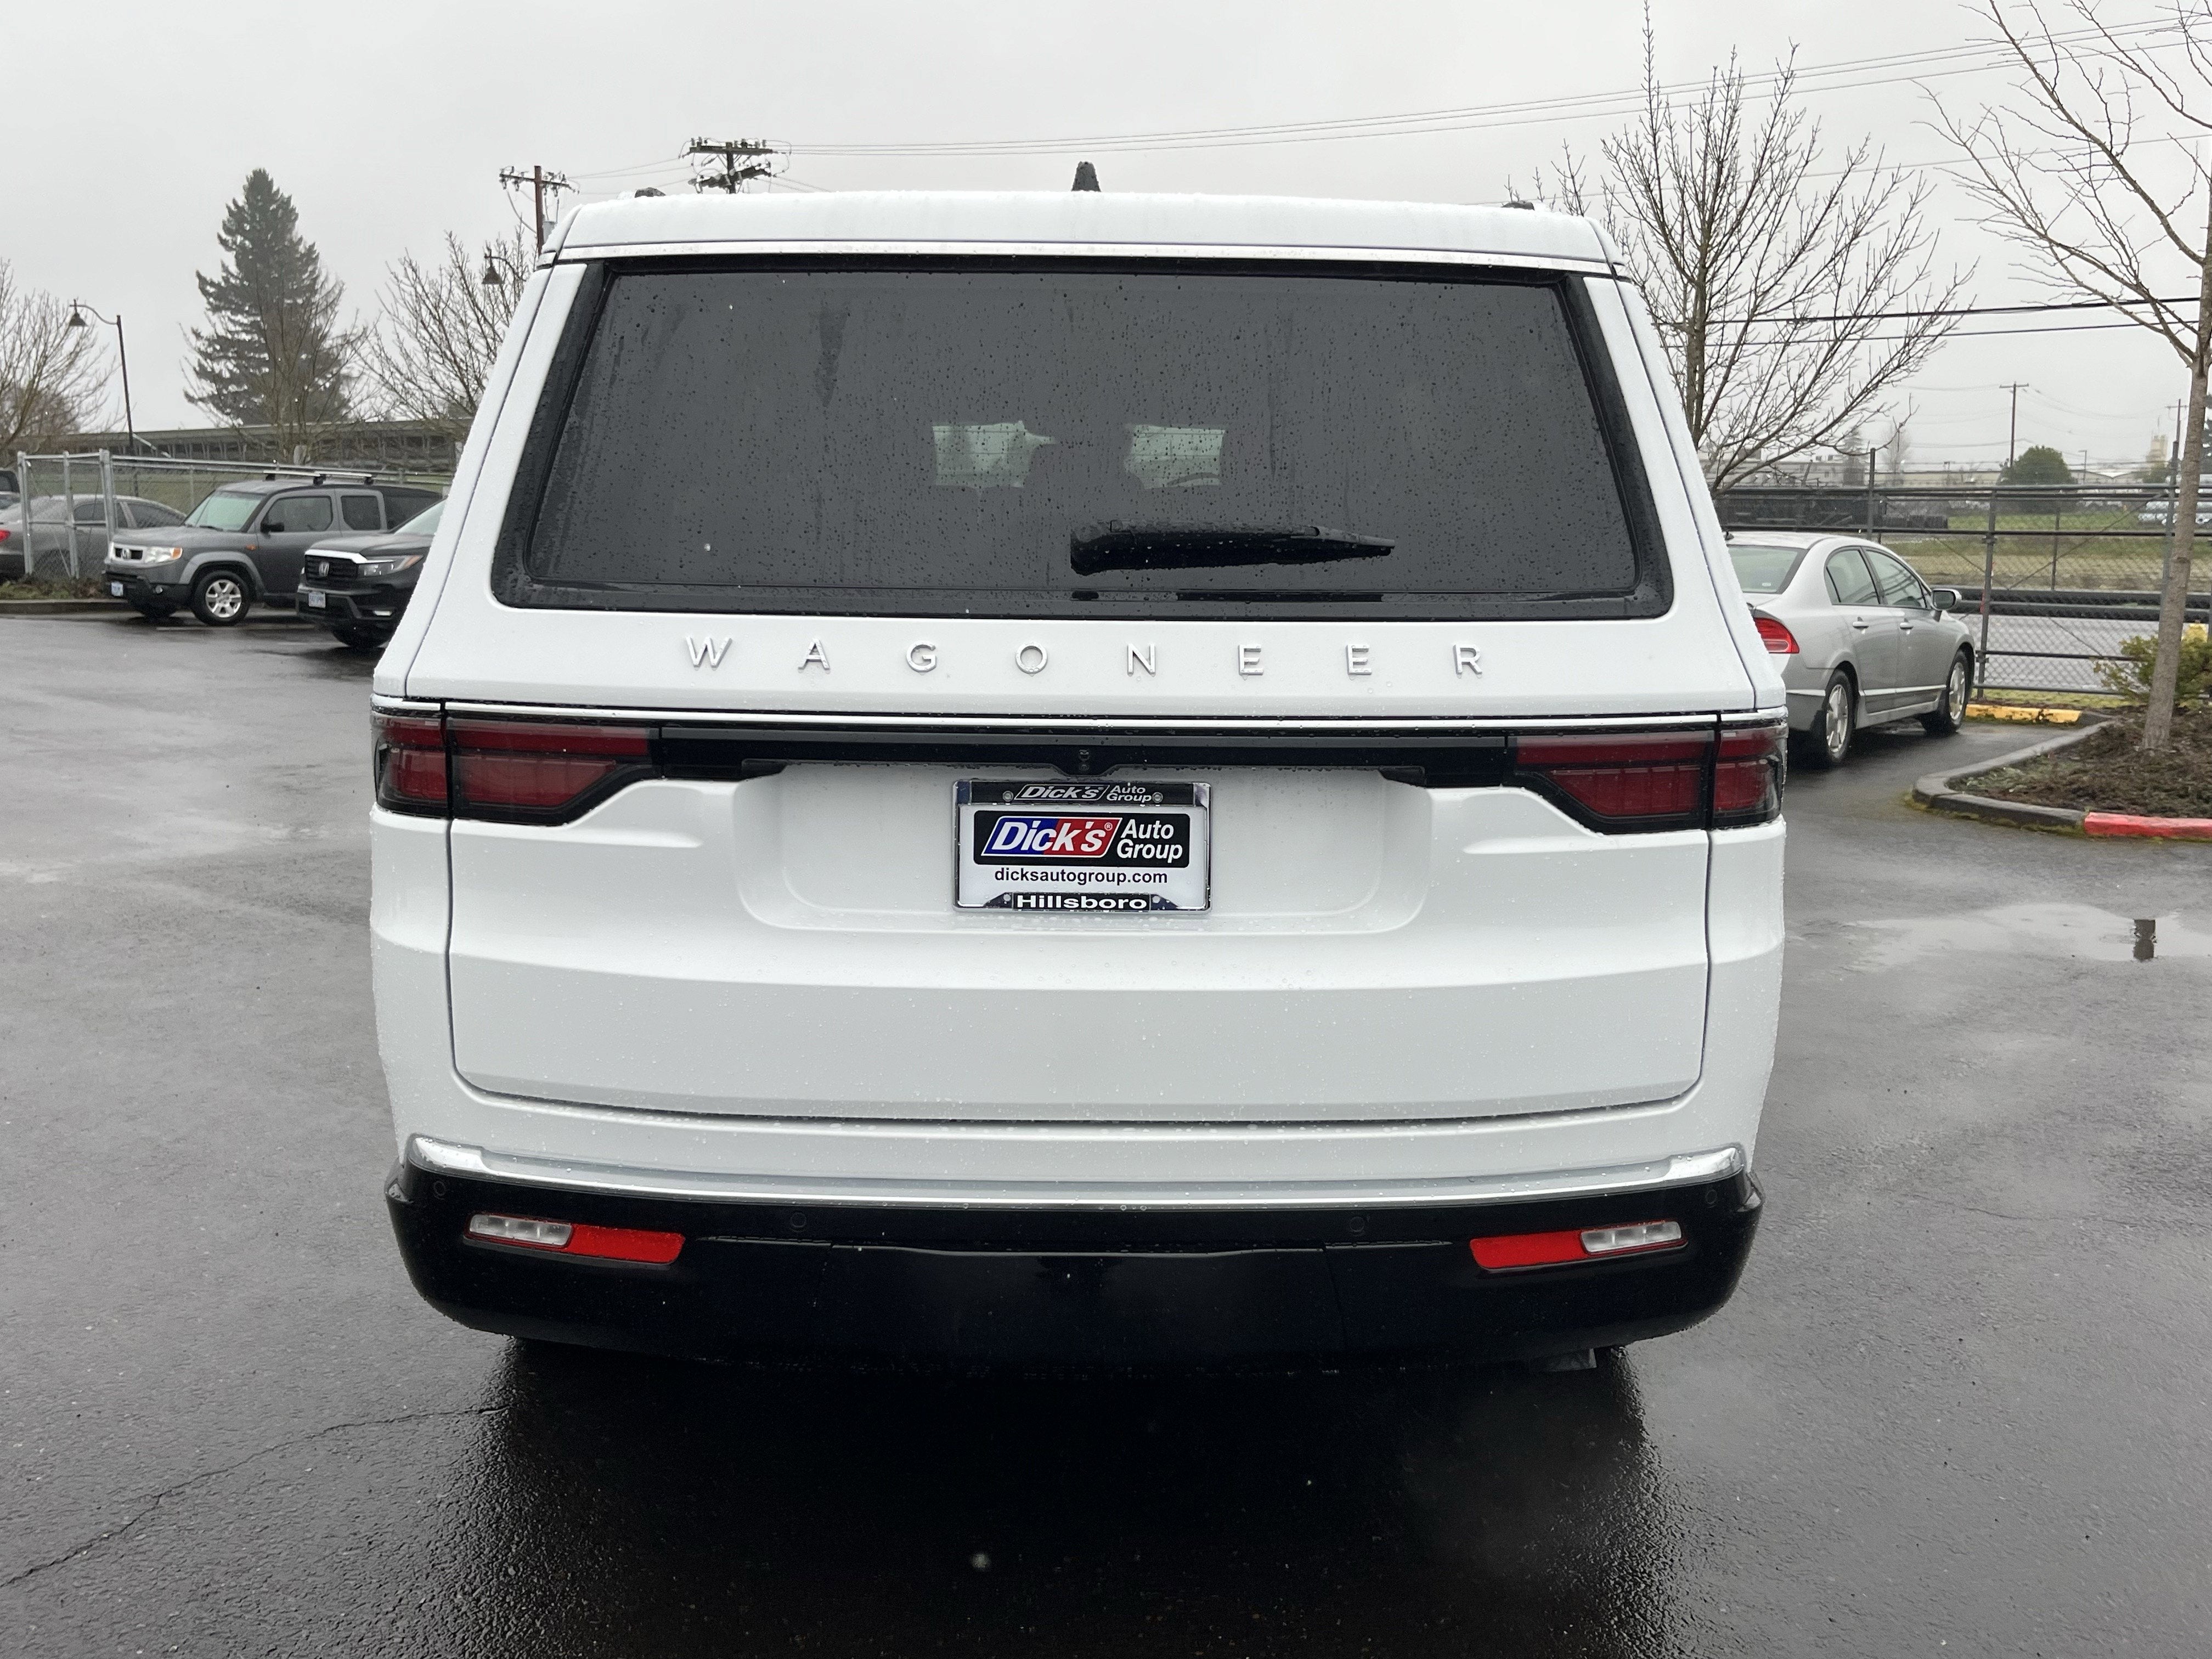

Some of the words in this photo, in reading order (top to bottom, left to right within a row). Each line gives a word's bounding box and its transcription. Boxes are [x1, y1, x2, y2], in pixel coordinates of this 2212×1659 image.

[685, 636, 1482, 675] WAGONEER
[1106, 793, 1152, 803] Group
[1110, 785, 1146, 794] Auto
[1120, 819, 1173, 839] Auto
[1116, 839, 1182, 862] Group
[995, 868, 1167, 885] dicksautogroup.com
[1017, 895, 1147, 909] Hillsboro
